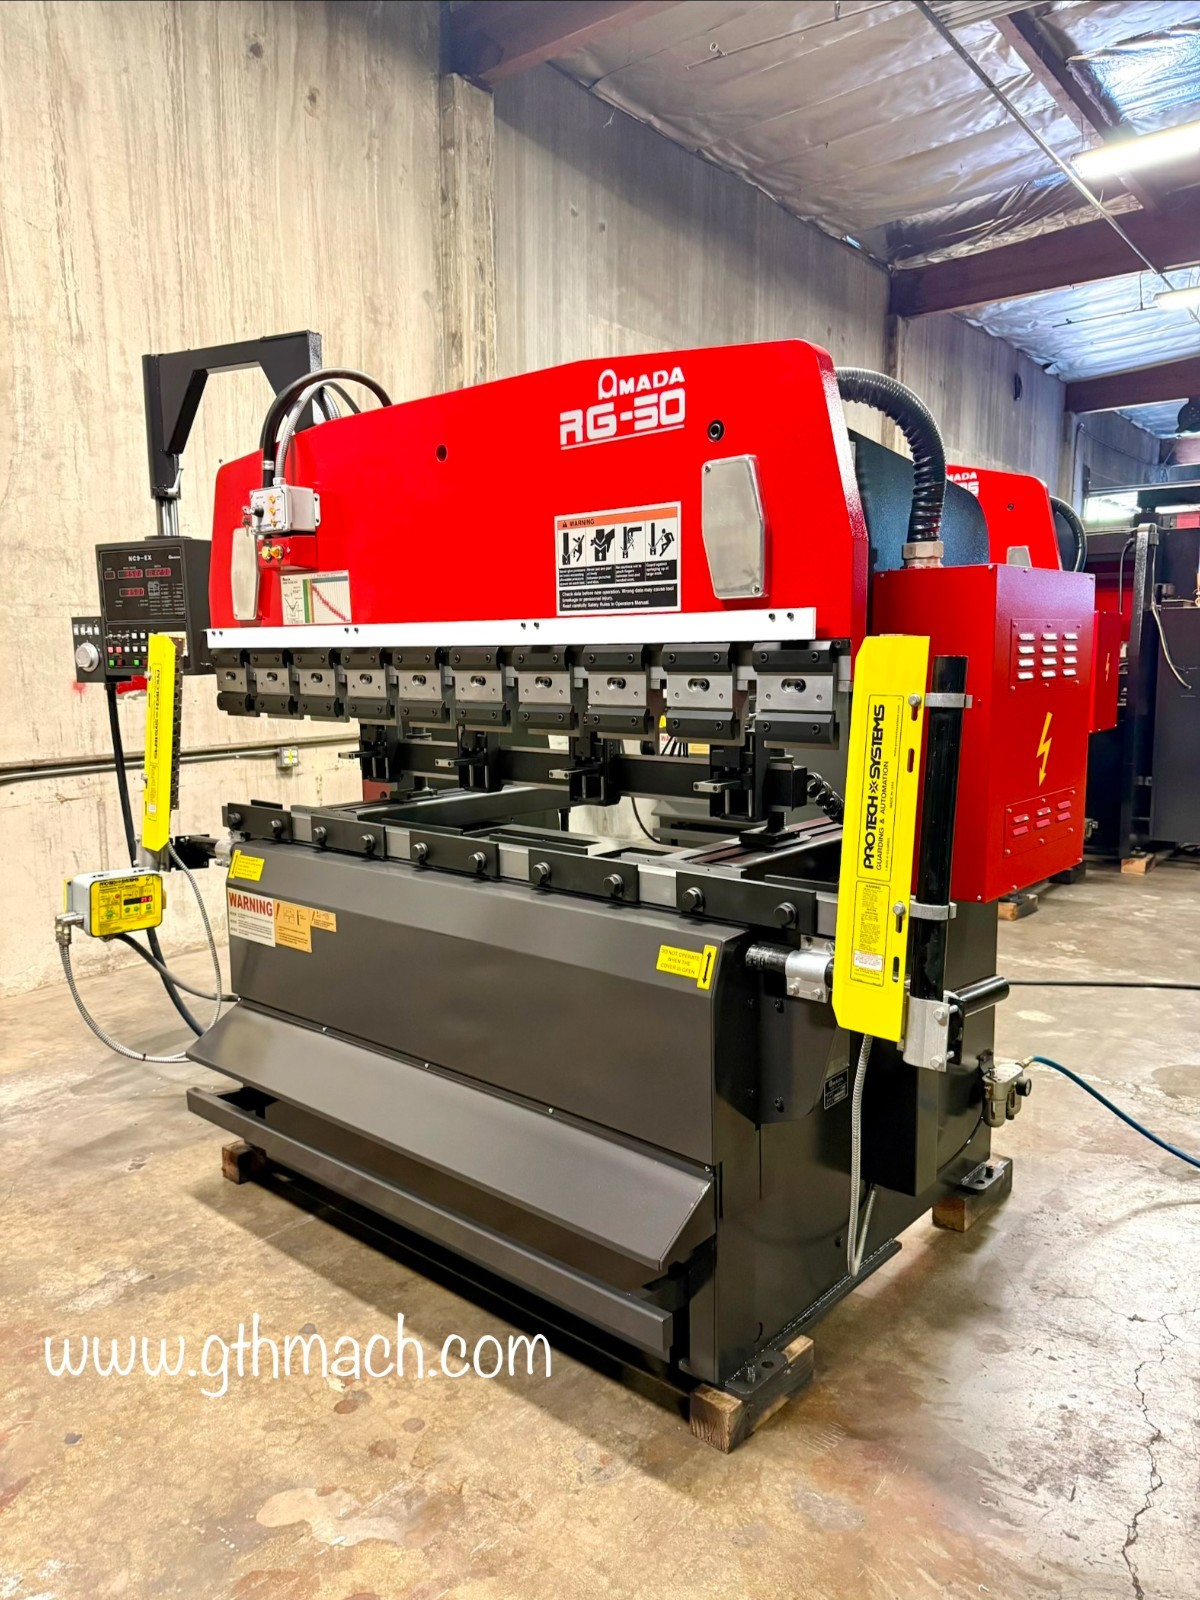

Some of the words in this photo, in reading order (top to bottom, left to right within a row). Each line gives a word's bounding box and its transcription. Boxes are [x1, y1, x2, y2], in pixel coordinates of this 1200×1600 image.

[597, 366, 685, 400] AMADA
[560, 387, 685, 446] RG-50
[946, 471, 978, 482] MADA
[569, 518, 595, 527] WARNING
[128, 554, 153, 562] NC9-EX
[869, 704, 885, 780] SYSTEMS
[880, 761, 889, 814] AUTOMATION
[863, 795, 878, 870] PROTECH
[876, 827, 885, 871] GUARDING
[228, 891, 273, 918] WARNING
[678, 952, 700, 961] OPERATE
